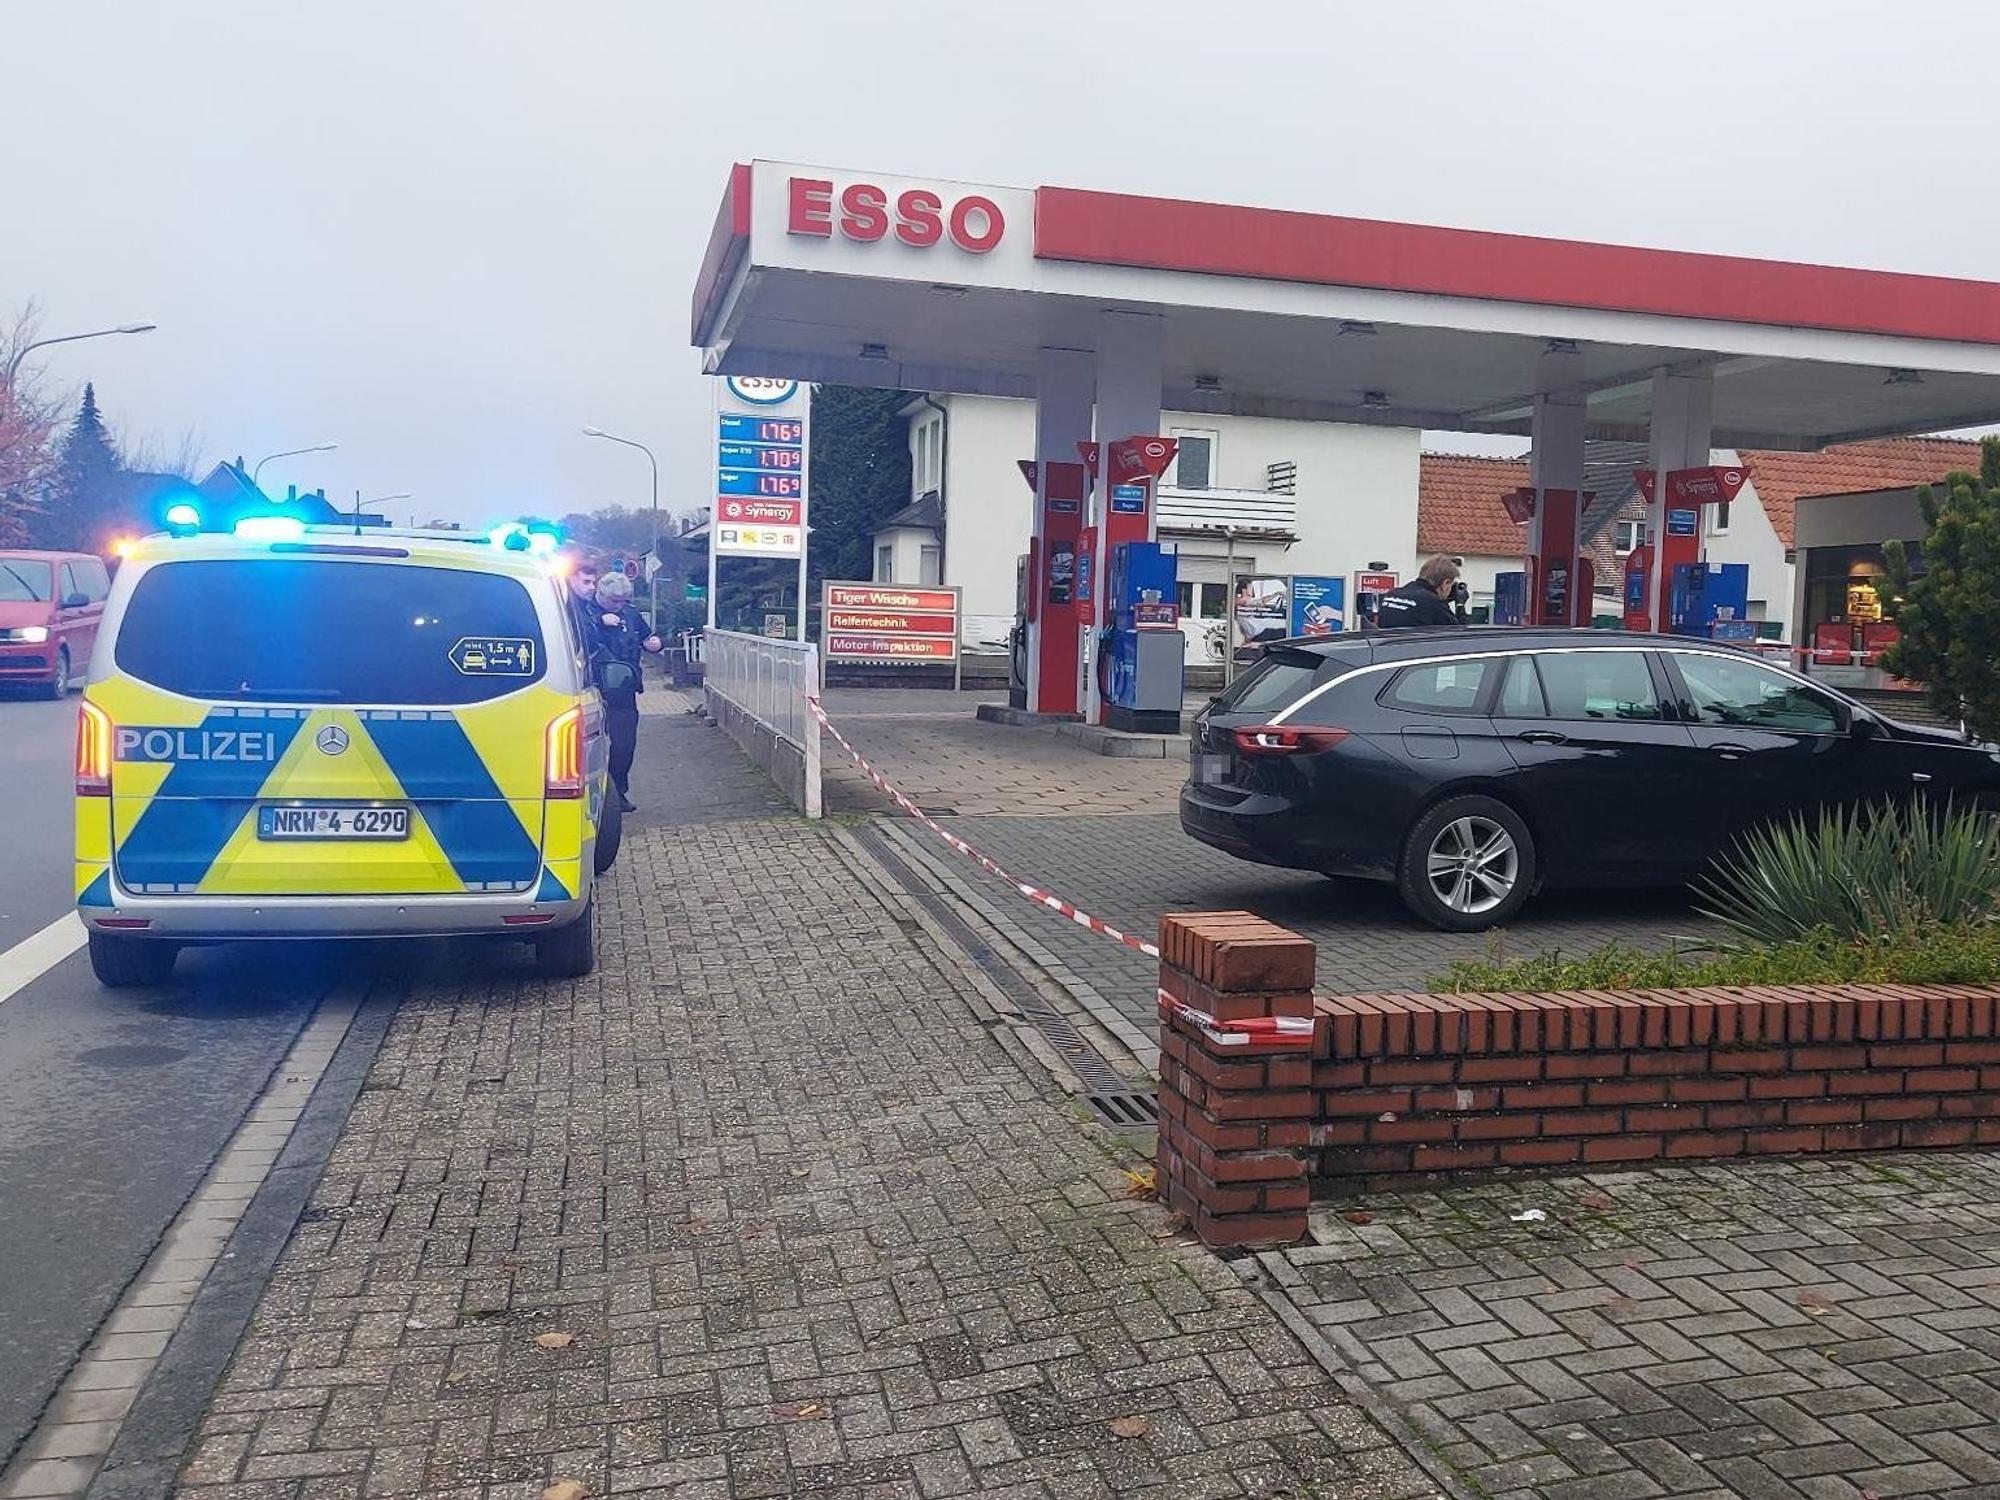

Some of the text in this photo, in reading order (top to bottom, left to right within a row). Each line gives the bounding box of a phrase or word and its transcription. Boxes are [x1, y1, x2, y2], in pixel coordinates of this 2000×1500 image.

[787, 176, 1006, 254] ESSO
[1088, 450, 1096, 462] 6
[745, 504, 794, 521] Synergy
[1363, 577, 1380, 585] Luft
[834, 590, 867, 605] Tiger
[833, 615, 909, 628] Reifentechnik
[487, 642, 504, 654] 1,5
[833, 638, 869, 650] Motor
[117, 729, 275, 761] POLIZEI
[274, 810, 317, 833] NRW
